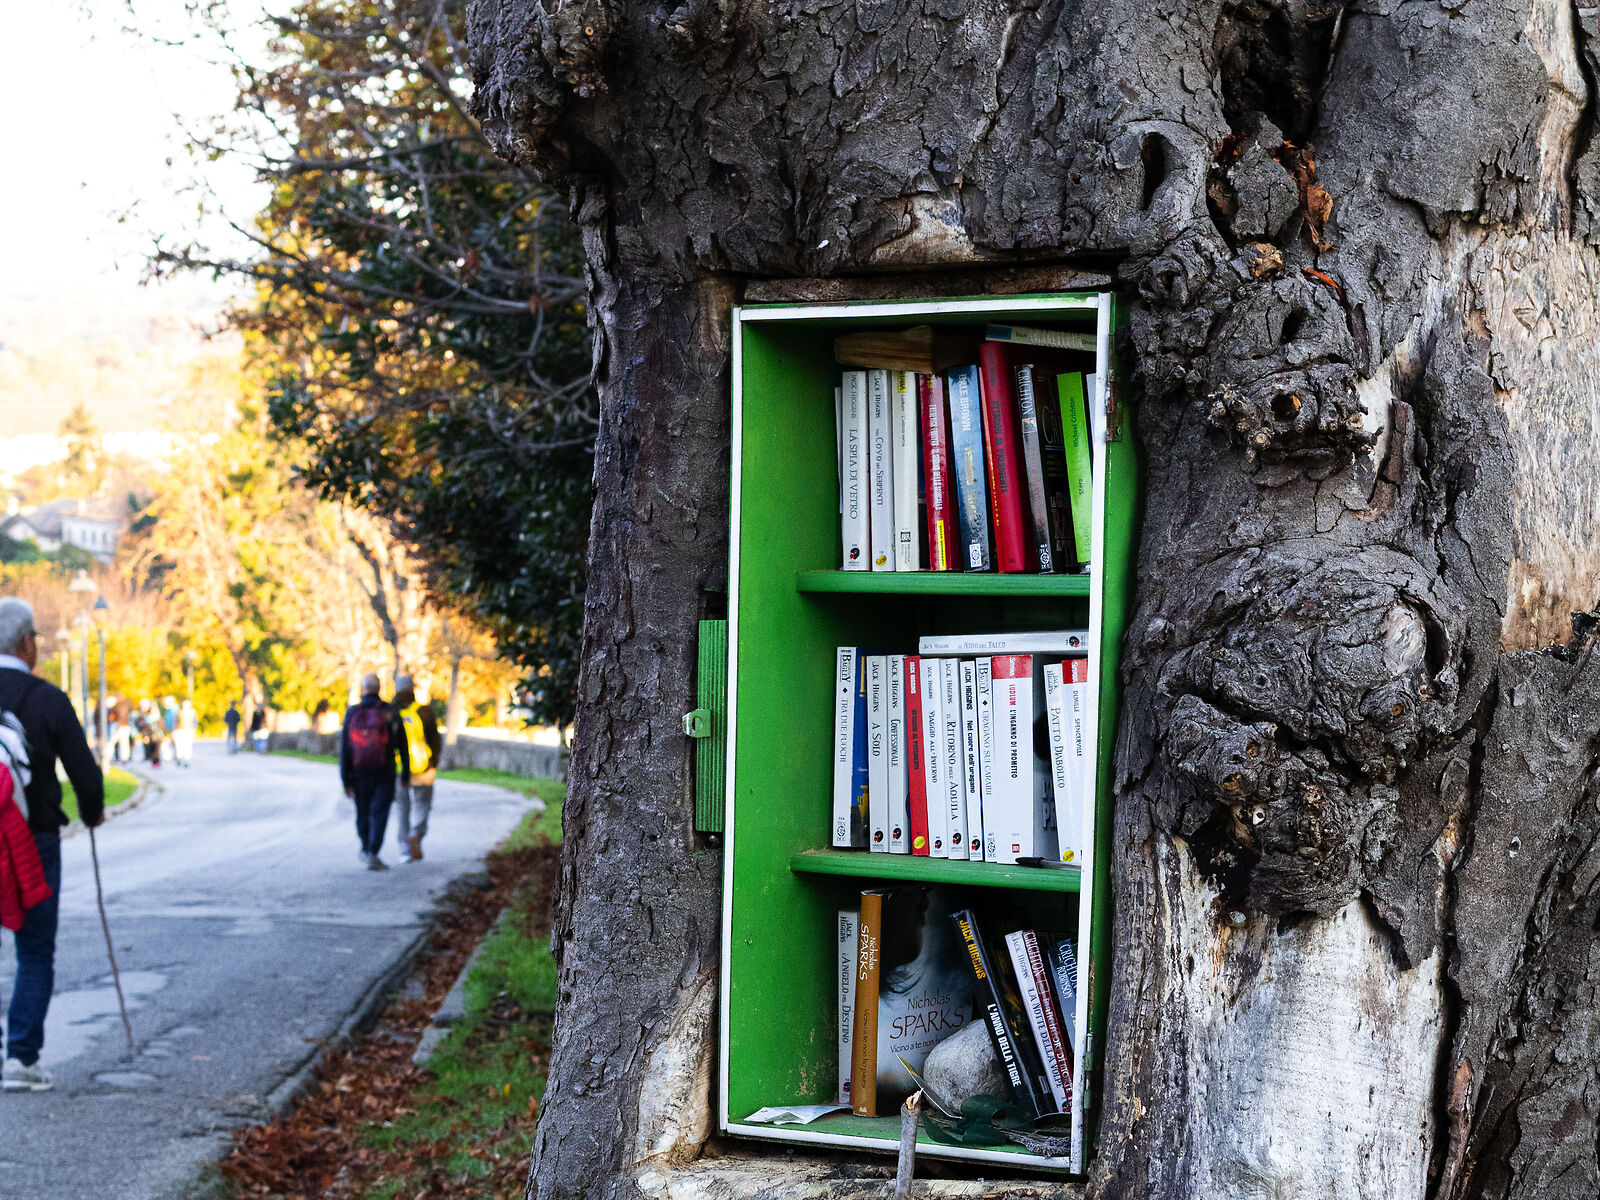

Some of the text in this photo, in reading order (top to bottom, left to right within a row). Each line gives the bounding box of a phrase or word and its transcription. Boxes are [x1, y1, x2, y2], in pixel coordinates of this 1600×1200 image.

[958, 374, 971, 431] DALE BROWN
[1017, 368, 1034, 416] CRICHTON
[849, 429, 858, 519] LA SPIA DI VETRO
[876, 470, 884, 506] SERPENTI
[987, 641, 1006, 649] FALCO
[841, 654, 852, 683] BAGLEY
[891, 657, 899, 708] JACK HIGGINS
[978, 667, 990, 695] BAGLEY
[1046, 670, 1054, 695] HIGGINS
[872, 661, 880, 713] JACK HIGGINS
[964, 666, 973, 710] JACK HIGGINS
[1008, 684, 1017, 706] LUDLUM
[840, 715, 848, 732] DUE
[872, 722, 881, 757] A SOLO
[928, 711, 936, 738] VIAGGIO
[966, 720, 974, 730] Nel
[982, 710, 991, 748] URAGANO
[1009, 709, 1018, 741] L'INGANNO
[1074, 718, 1083, 757] SPENCERVILLE
[839, 733, 848, 763] FUOCHI
[890, 719, 901, 768] CONFESSIONALE
[946, 720, 957, 765] RITORNO
[1050, 707, 1066, 789] PATTO DIABOLICO
[967, 752, 976, 794] dell'uragano
[984, 764, 992, 796] CARAIBI
[1010, 749, 1019, 779] PROMETEO
[949, 781, 959, 821] AQUILA
[839, 916, 847, 943] HIGGINS
[859, 923, 869, 981] SPARKS
[868, 936, 879, 970] Nicholas
[959, 919, 986, 980] JACK HIGGINS
[1011, 936, 1030, 978] JACK HIGGINS
[1023, 931, 1046, 977] CRICHTON
[907, 987, 951, 1011] Nicholas
[1056, 966, 1073, 1000] ROBINSON
[841, 1005, 851, 1043] DESTINO
[889, 1005, 965, 1040] SPARKS
[1027, 987, 1063, 1089] LA NOTTE DELLA VOLPE
[861, 1057, 869, 1067] ho
[890, 1043, 910, 1053] Vicino
[915, 1041, 922, 1049] te
[922, 1039, 935, 1047] non
[987, 1003, 1022, 1087] L'ANNO DELLA TIGRE
[860, 1068, 868, 1089] paura
